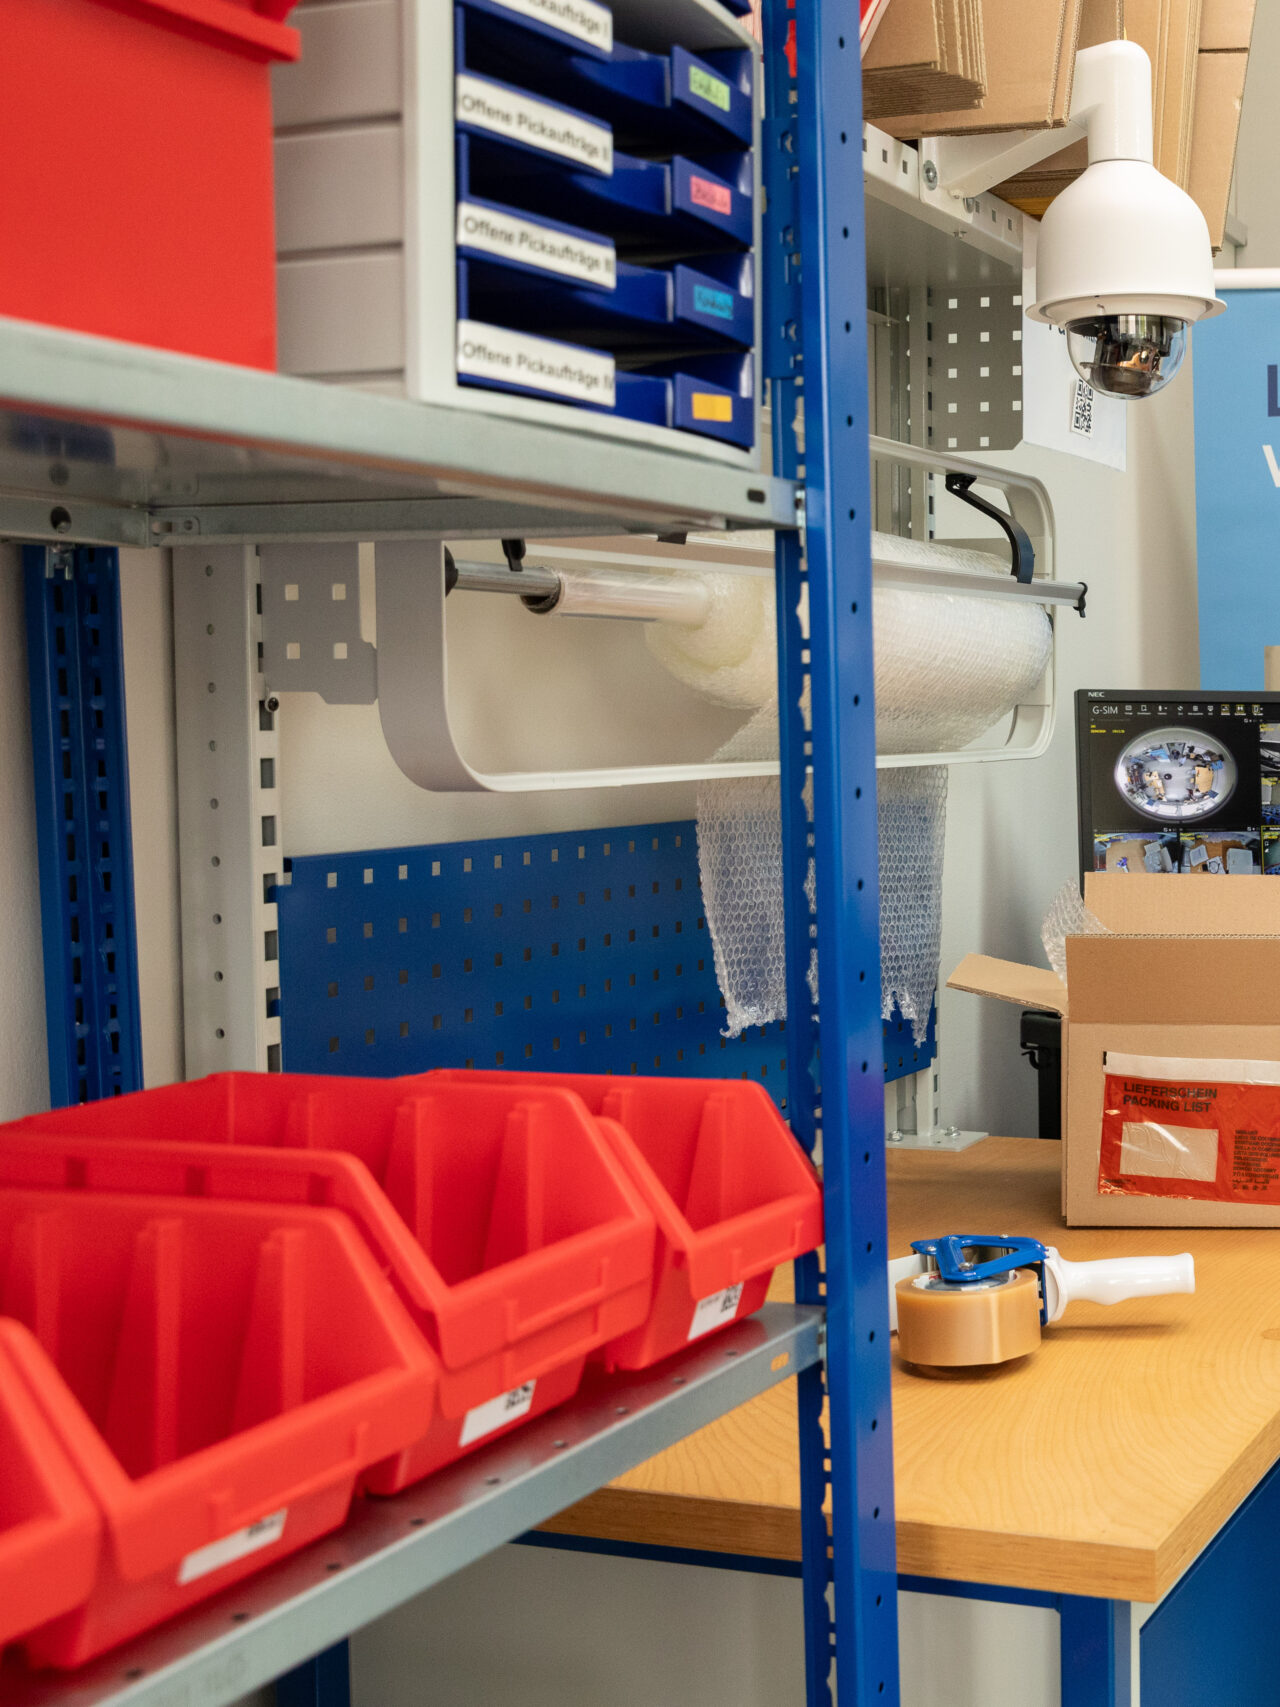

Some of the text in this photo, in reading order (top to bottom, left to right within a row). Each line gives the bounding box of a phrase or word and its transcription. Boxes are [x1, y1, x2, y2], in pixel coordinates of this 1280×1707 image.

[461, 93, 513, 126] Offene
[516, 112, 600, 159] Pickaufträge
[464, 216, 515, 245] Offene
[518, 230, 601, 272] Pickaufträge
[462, 341, 513, 365] Offene
[516, 352, 600, 390] Pickaufträge
[1092, 705, 1118, 715] G-SIM
[1123, 1082, 1218, 1099] LIEFERSCHEIN
[1123, 1094, 1212, 1113] PACKING LIST
